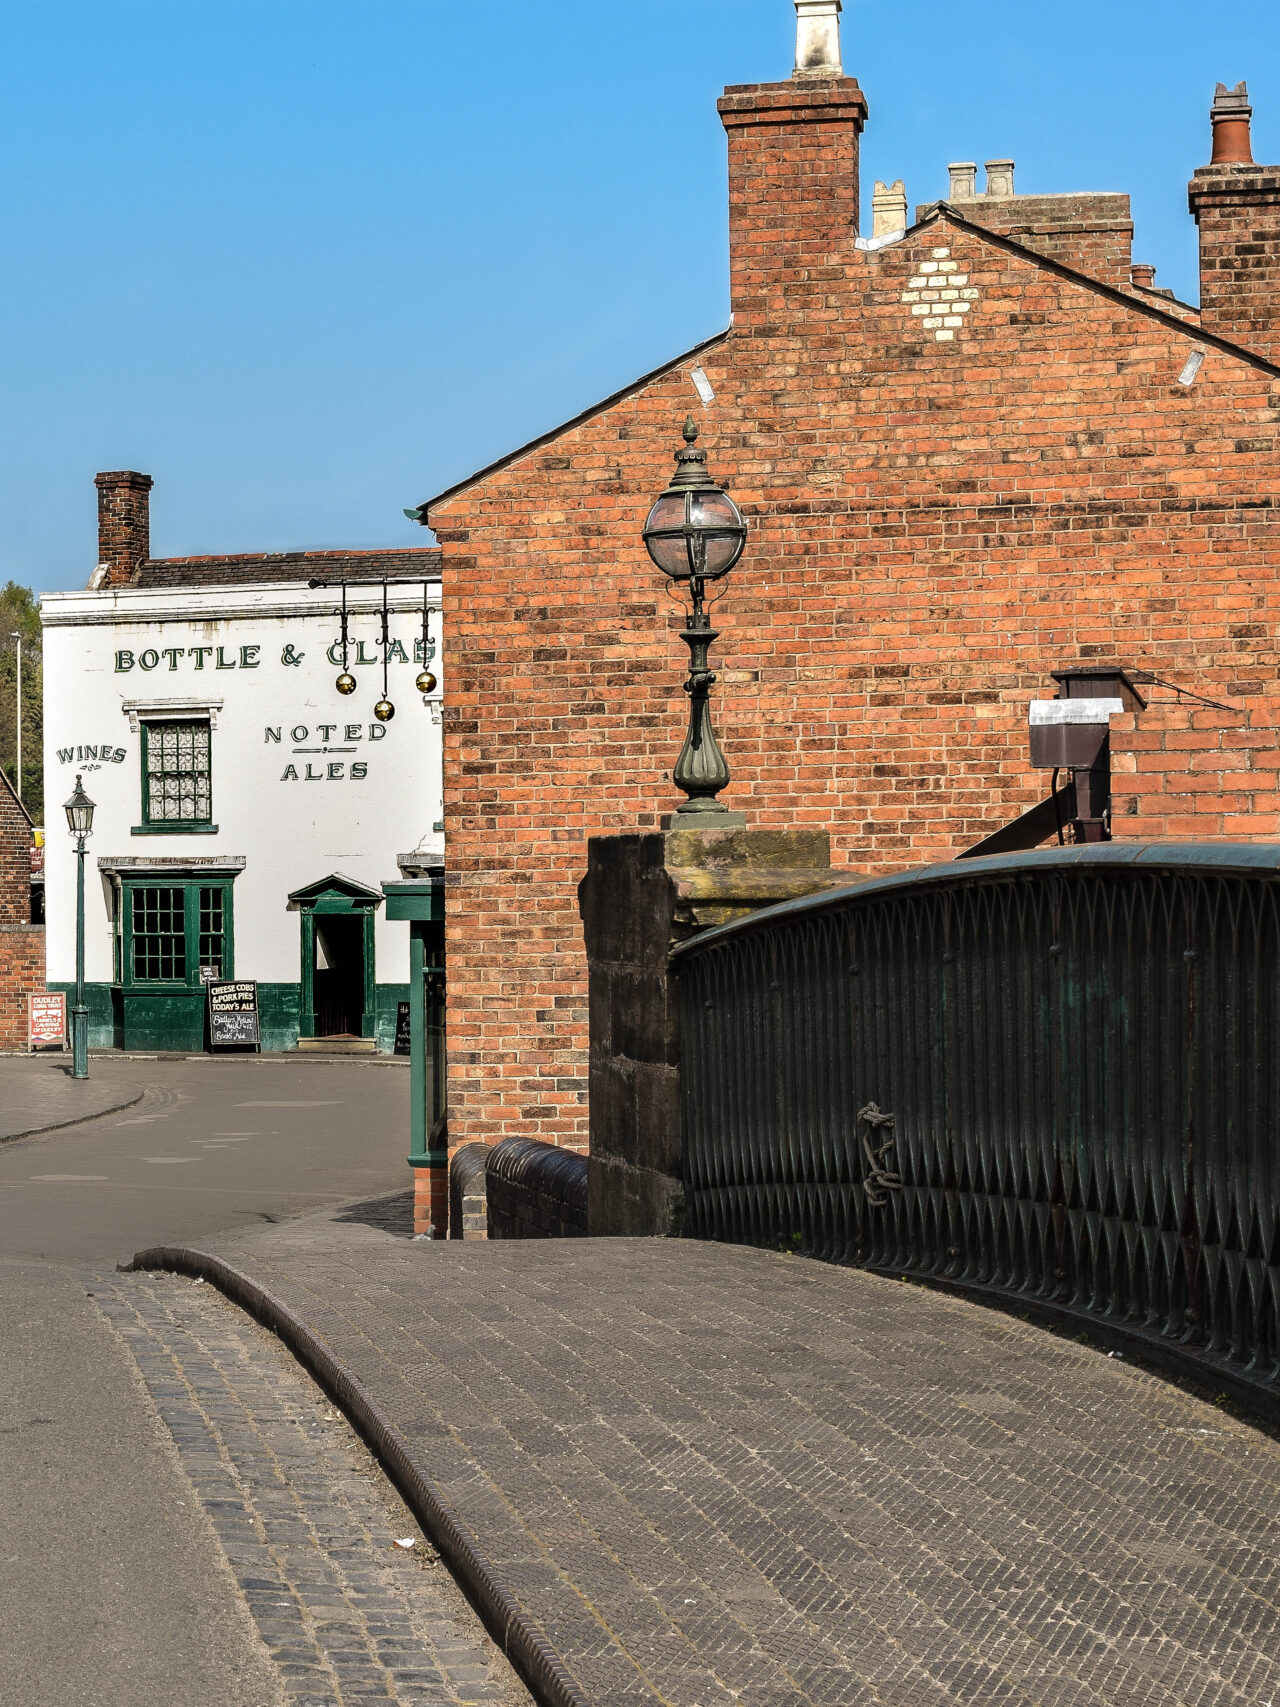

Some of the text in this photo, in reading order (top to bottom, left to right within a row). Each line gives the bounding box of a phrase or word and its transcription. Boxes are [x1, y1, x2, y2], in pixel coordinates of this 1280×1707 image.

[114, 645, 261, 673] BOTTLE
[280, 643, 305, 667] &
[264, 723, 387, 743] NOTED
[56, 745, 127, 764] WINES
[279, 762, 368, 781] ALES
[211, 984, 254, 995] CHEESE COBS
[212, 992, 253, 1004] & PORK PIES
[212, 1002, 239, 1011] TODAY'S
